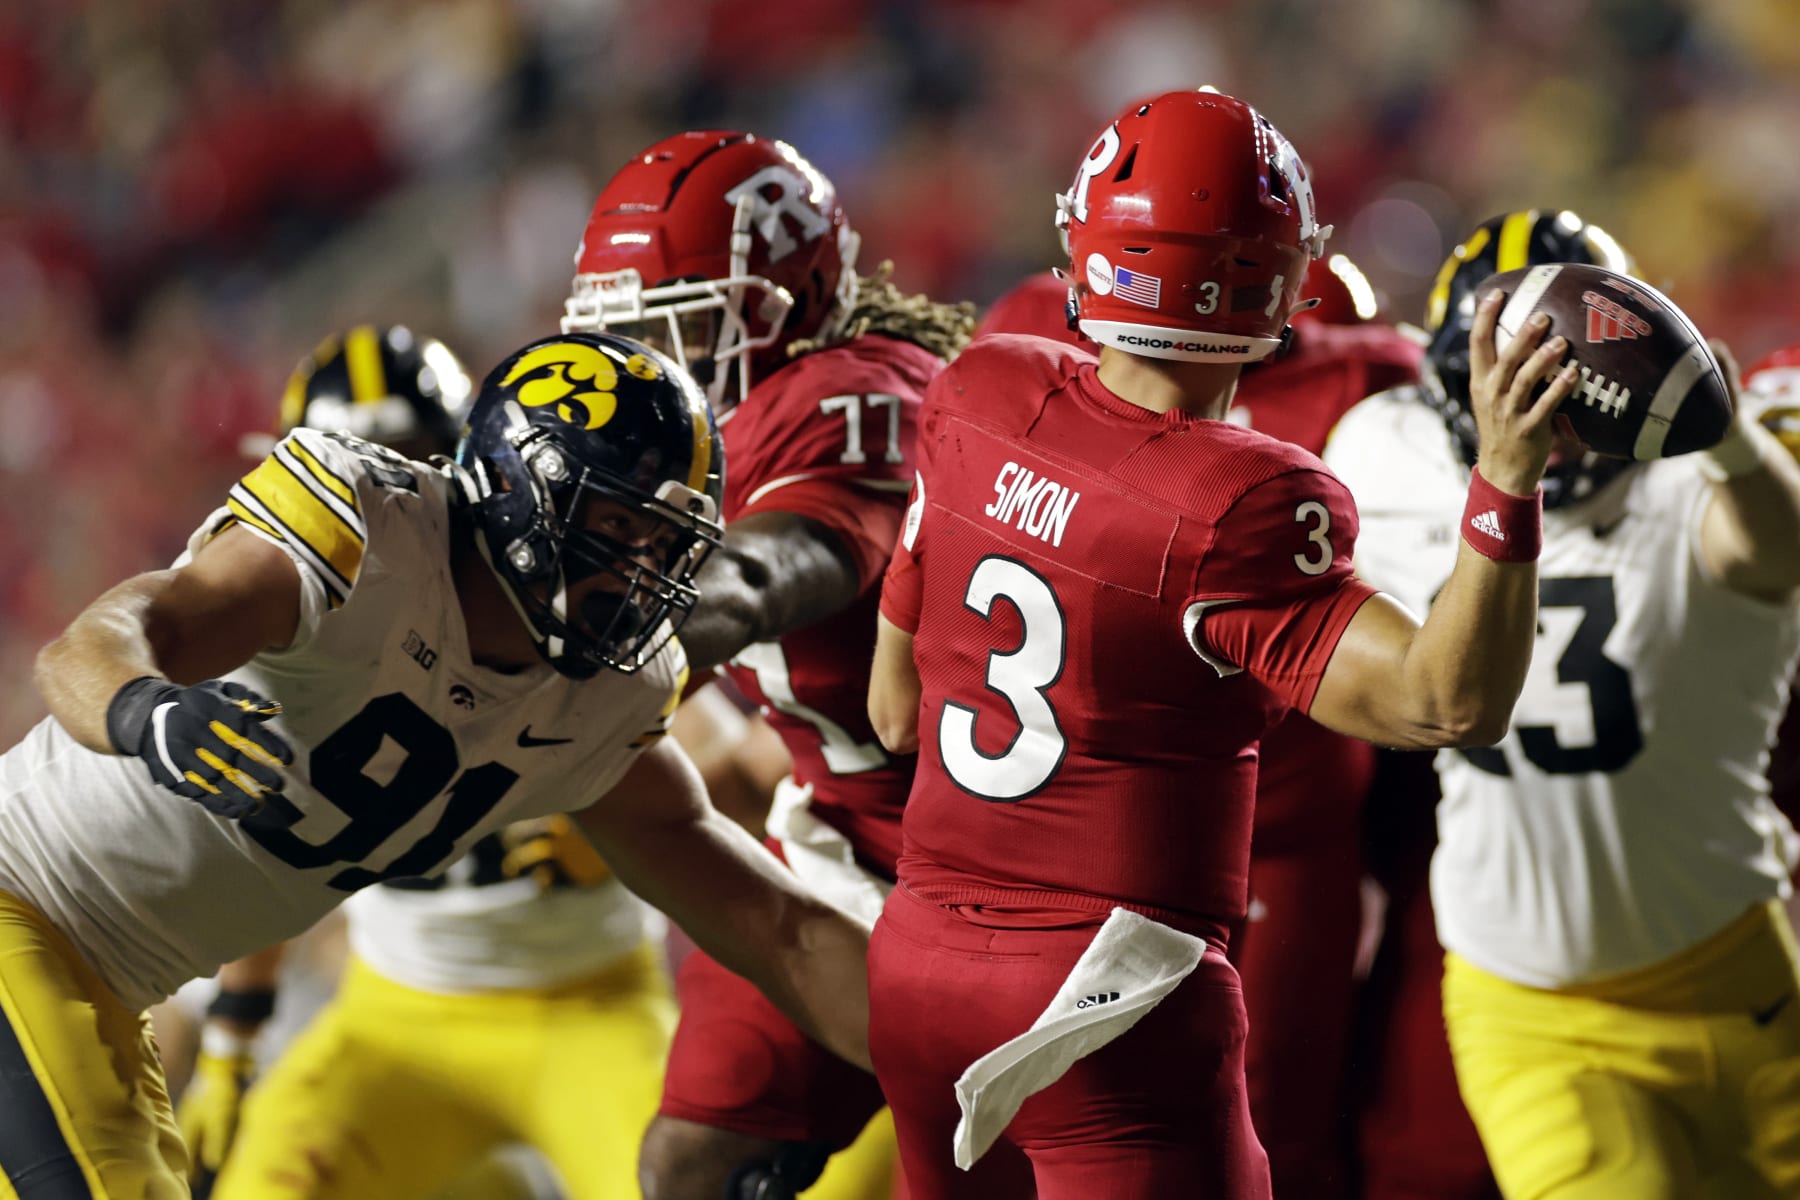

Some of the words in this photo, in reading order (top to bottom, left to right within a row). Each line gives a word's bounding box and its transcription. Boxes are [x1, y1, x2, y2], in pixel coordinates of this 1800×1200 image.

[724, 165, 831, 265] R
[1194, 281, 1220, 315] 3
[1117, 334, 1250, 354] #CHOP4CHANGE
[819, 394, 904, 464] 77
[986, 461, 1080, 547] SIMON
[1294, 501, 1334, 575] 3
[1471, 517, 1505, 541] adidas
[937, 553, 1068, 803] 3
[238, 691, 520, 892] 91
